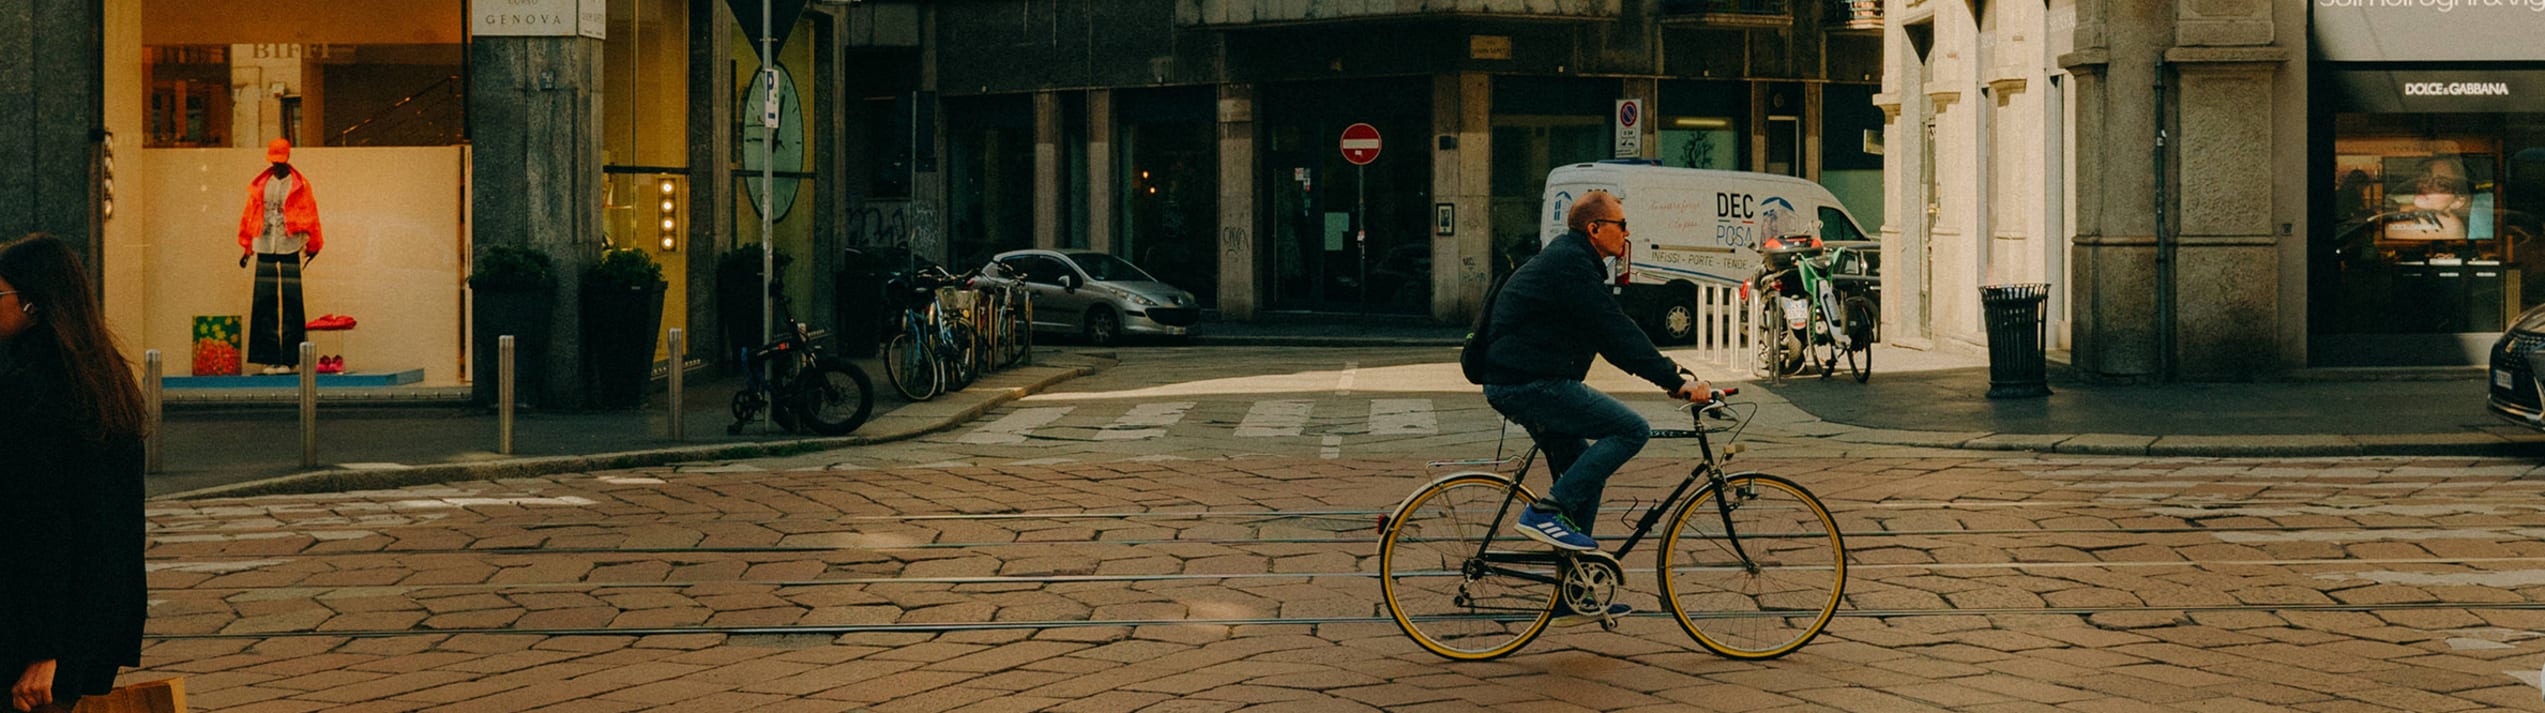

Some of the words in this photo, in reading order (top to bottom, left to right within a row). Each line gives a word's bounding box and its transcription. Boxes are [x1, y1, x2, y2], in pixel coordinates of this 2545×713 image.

[486, 15, 561, 25] GENOVA
[253, 44, 330, 59] BIFFI
[1717, 192, 1754, 219] DEC
[1716, 225, 1753, 247] POSA
[1688, 254, 1714, 267] PORTE
[1723, 258, 1747, 270] TENDE
